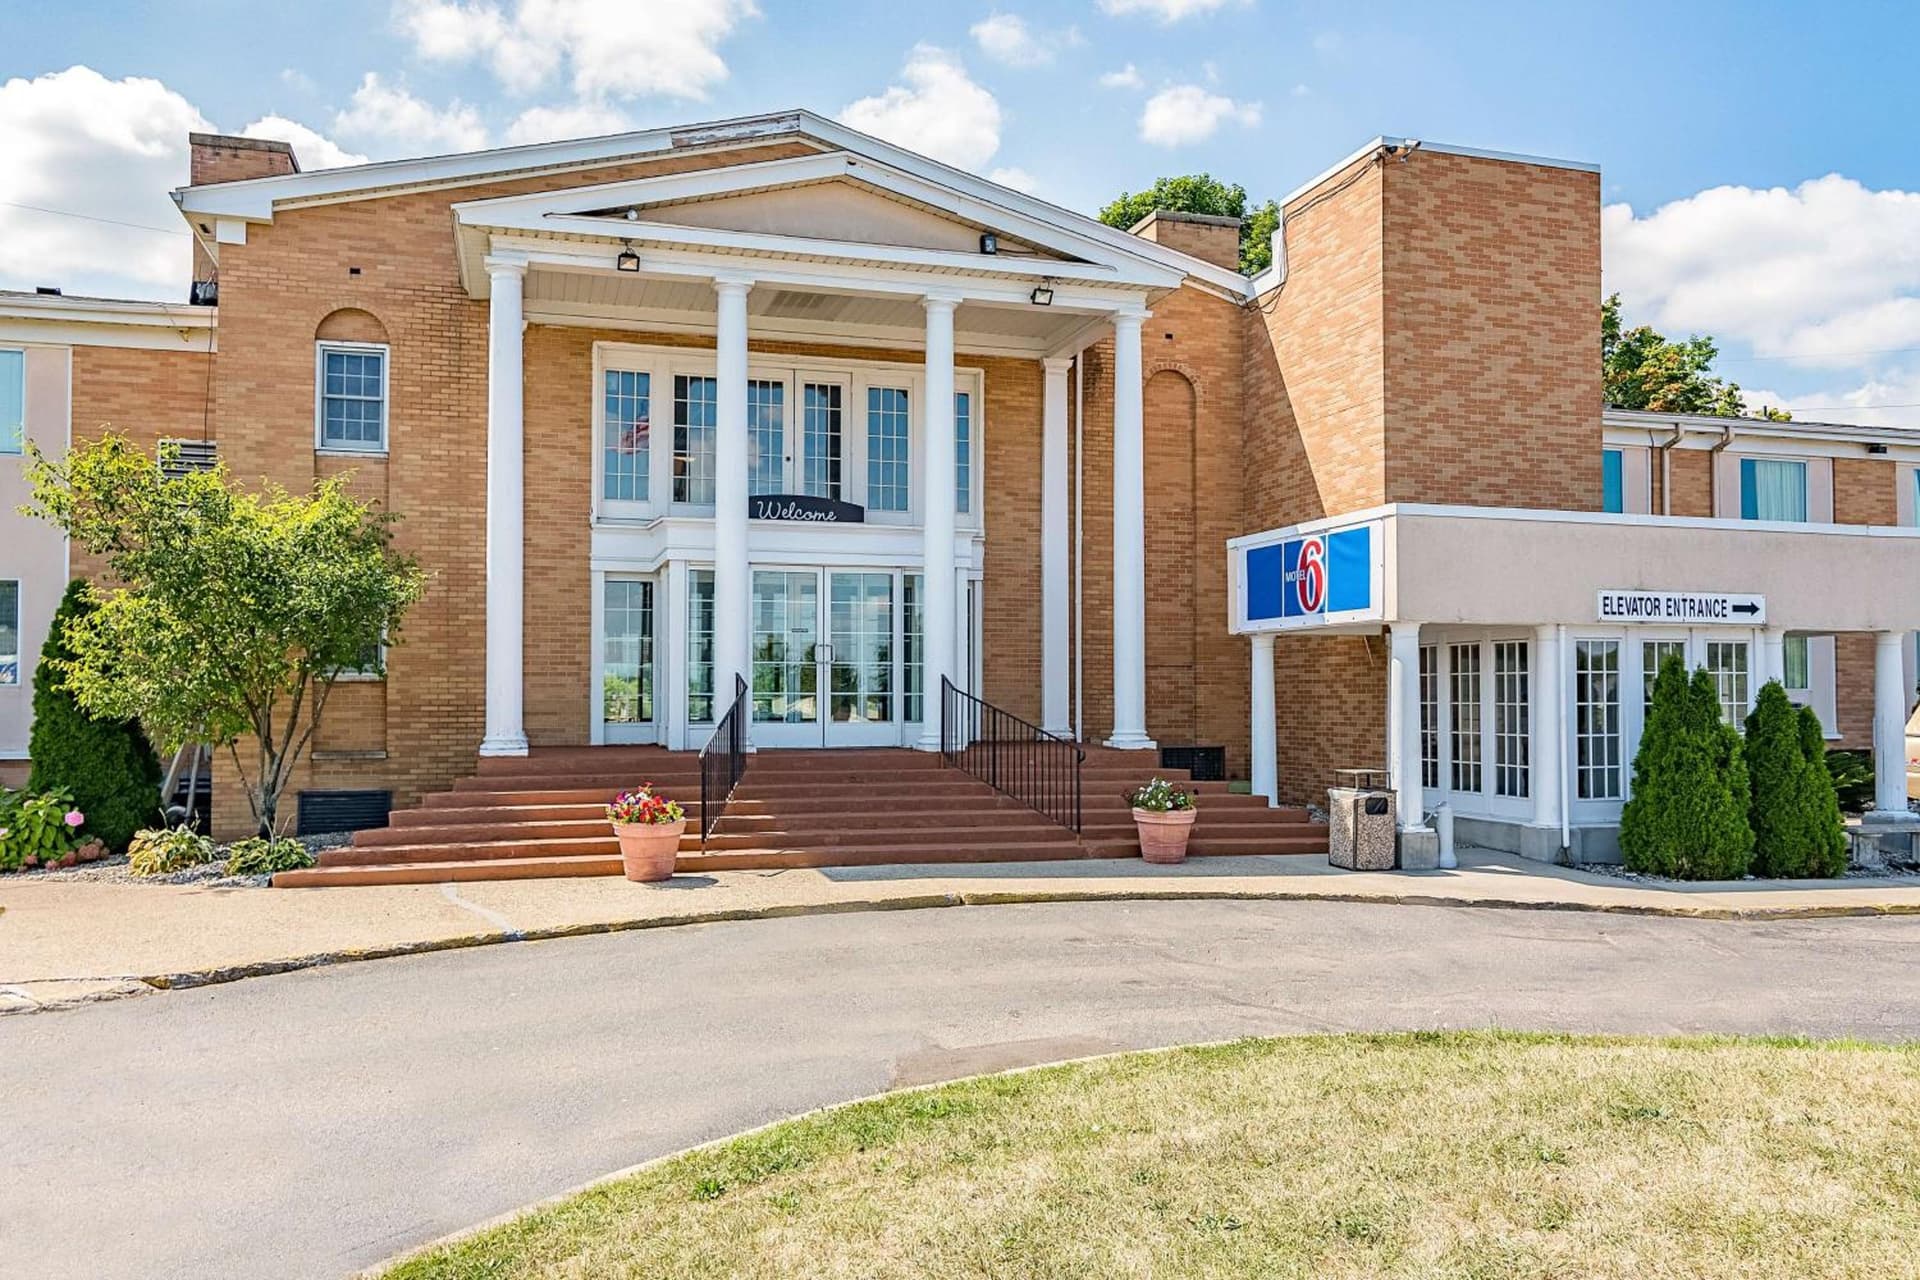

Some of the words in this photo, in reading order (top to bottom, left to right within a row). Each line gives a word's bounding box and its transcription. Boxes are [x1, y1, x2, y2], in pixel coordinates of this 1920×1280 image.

[757, 500, 837, 521] Welcome
[1285, 570, 1306, 582] MOTEL
[1297, 539, 1324, 613] 6
[1602, 596, 1661, 616] ELEVATOR
[1666, 597, 1728, 618] ENTRANCE
